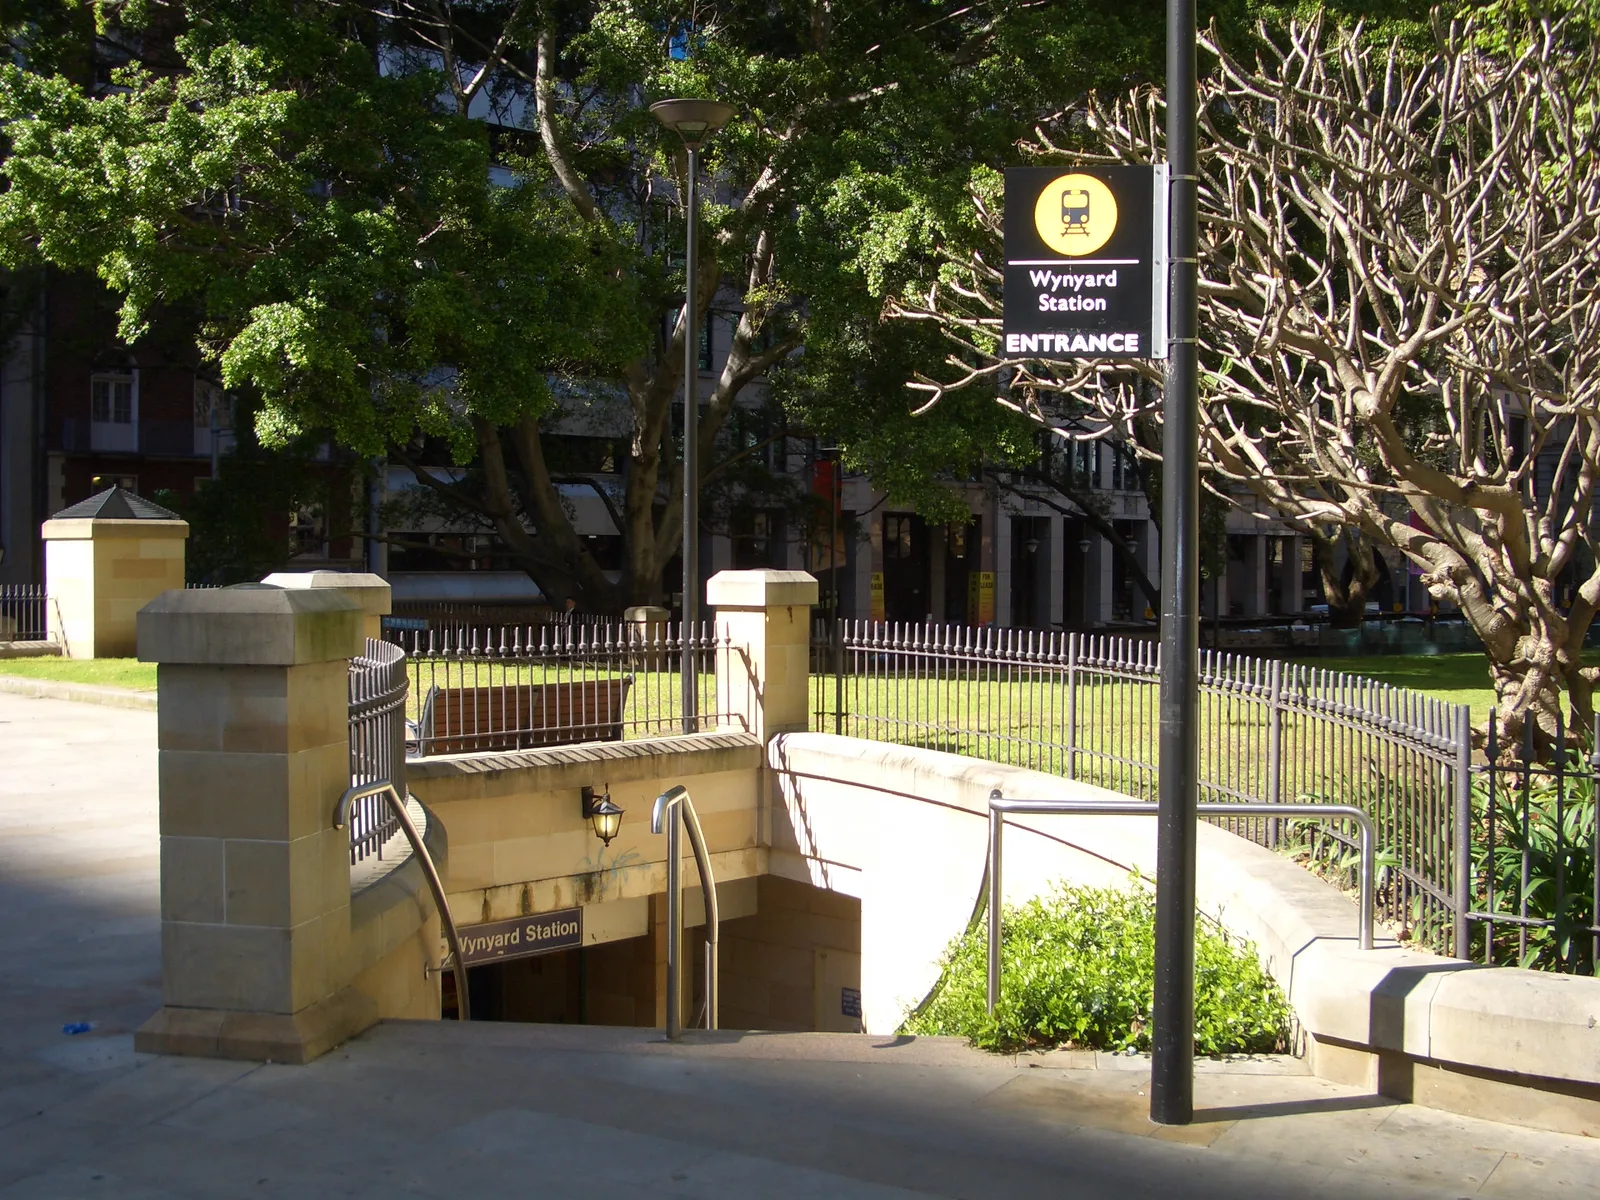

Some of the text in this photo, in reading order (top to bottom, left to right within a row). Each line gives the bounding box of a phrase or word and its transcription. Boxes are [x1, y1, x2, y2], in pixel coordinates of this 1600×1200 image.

[1029, 269, 1118, 292] Wynyard
[1038, 293, 1106, 312] Station
[1006, 333, 1139, 353] ENTRANCE
[526, 920, 578, 942] Station
